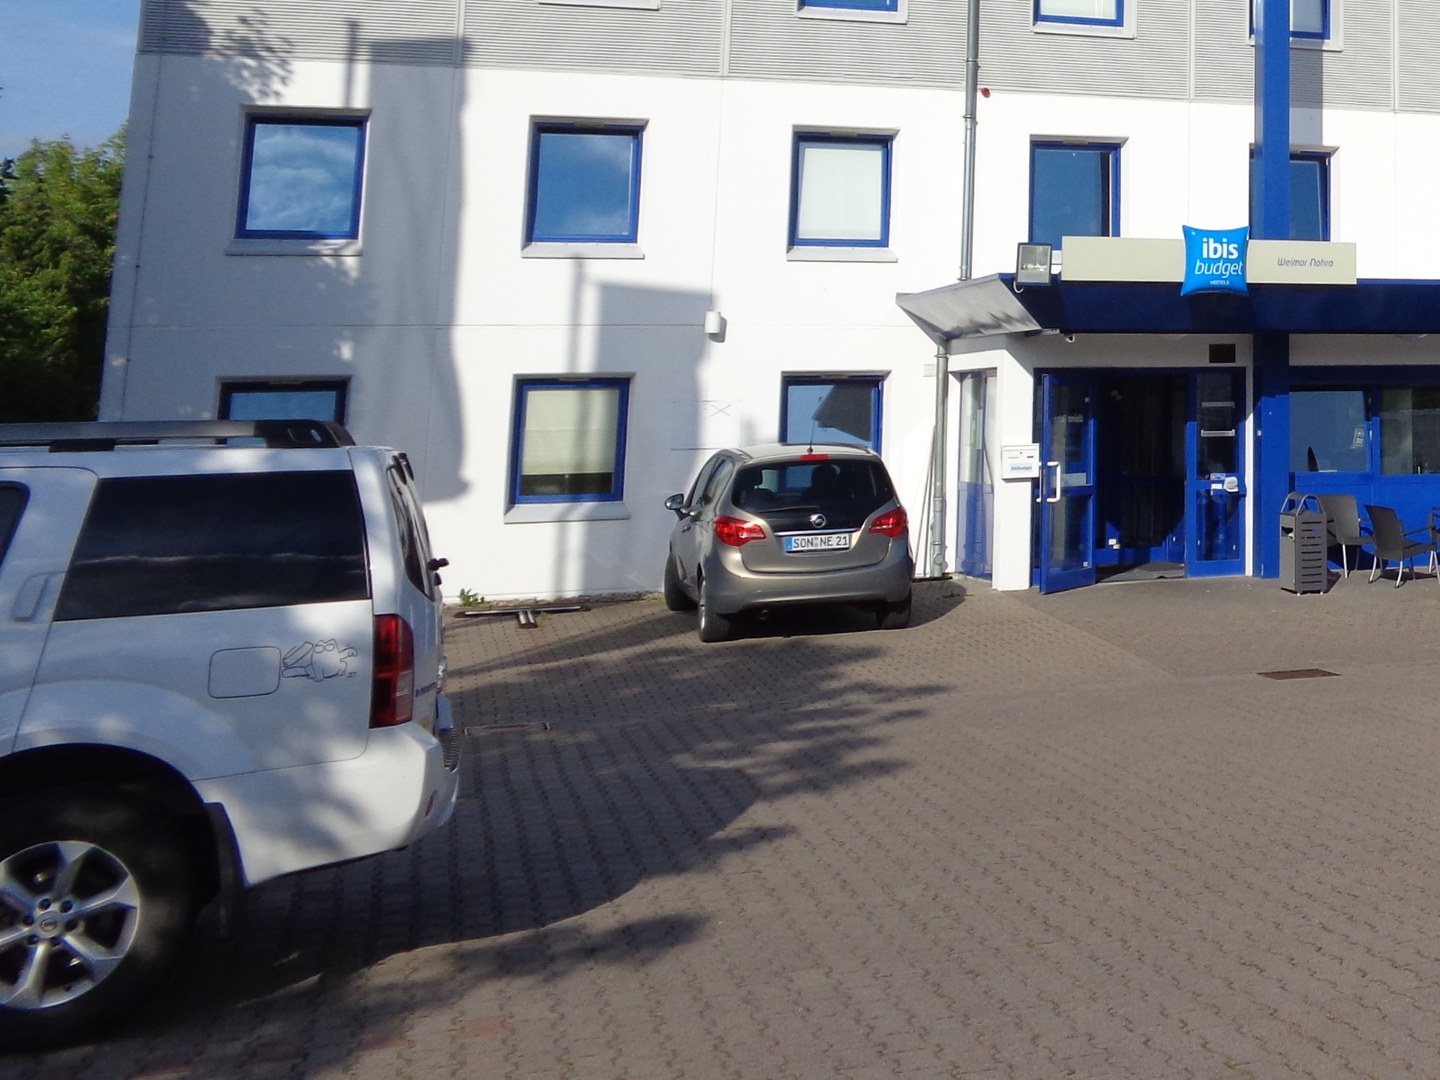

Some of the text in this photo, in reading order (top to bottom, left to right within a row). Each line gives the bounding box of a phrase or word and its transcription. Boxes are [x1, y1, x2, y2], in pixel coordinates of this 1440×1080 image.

[1202, 237, 1239, 259] ibis
[1194, 259, 1244, 279] budget
[1277, 257, 1308, 267] Weimar
[793, 535, 848, 549] SON NE 21
